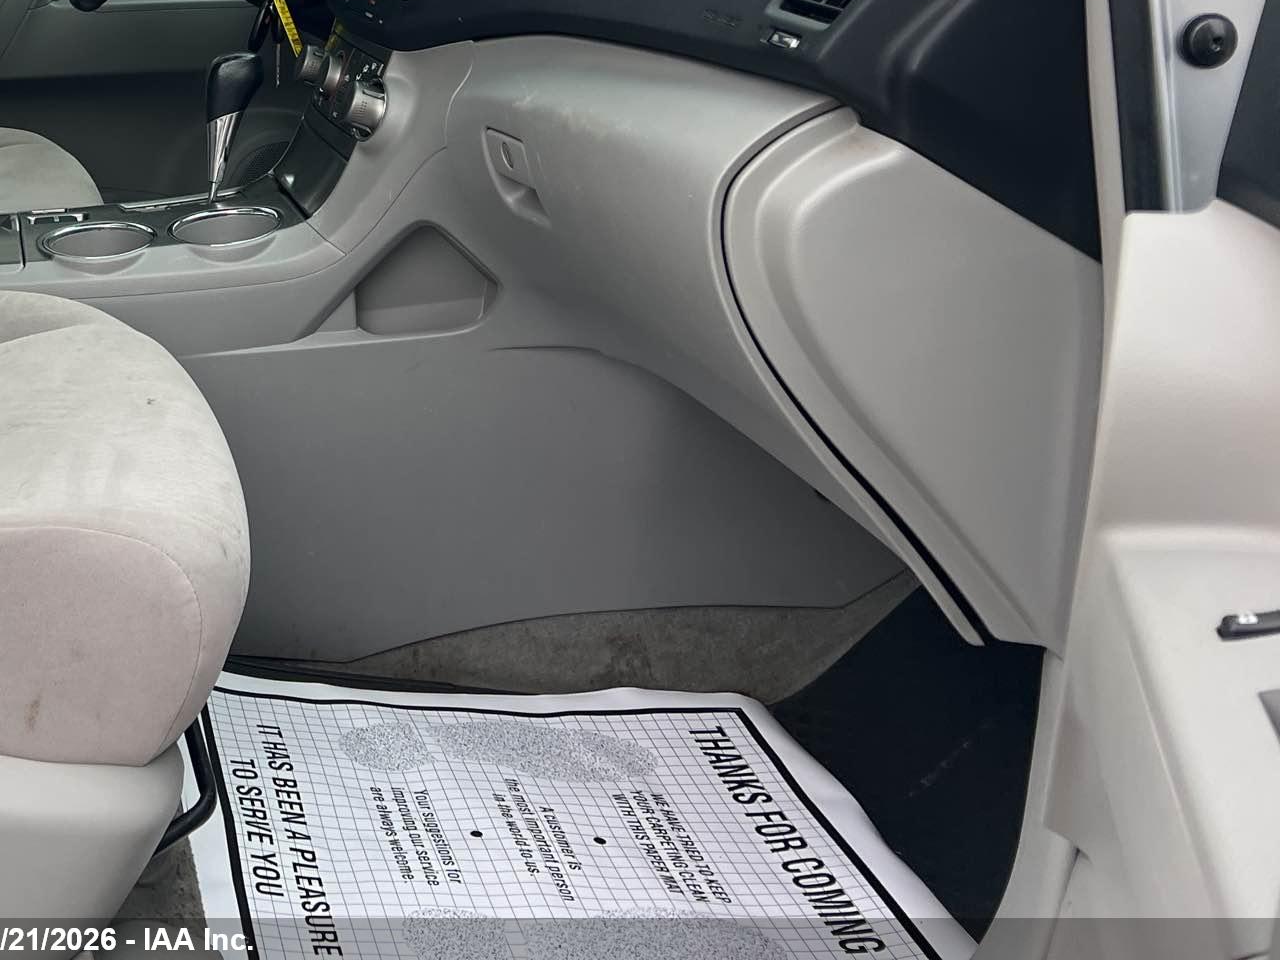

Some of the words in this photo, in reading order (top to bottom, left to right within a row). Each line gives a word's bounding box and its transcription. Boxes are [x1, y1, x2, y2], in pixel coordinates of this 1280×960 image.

[256, 724, 283, 739] IT
[230, 759, 258, 780] TO
[262, 741, 294, 772] HAS
[272, 777, 307, 825] BEEN
[370, 786, 384, 803] are
[391, 786, 417, 831] improving
[414, 789, 431, 815] Your
[493, 792, 506, 803] in
[650, 793, 670, 808] WE
[236, 785, 274, 845] SERVE
[376, 804, 397, 837] always
[497, 804, 514, 820] the
[660, 809, 686, 833] HAVE
[284, 828, 312, 841] A
[409, 833, 425, 848] our
[422, 811, 455, 867] suggestions
[505, 778, 520, 793] the
[513, 794, 534, 816] most
[525, 817, 556, 868] important
[545, 866, 575, 902] person
[506, 821, 530, 849] world
[544, 813, 576, 860] customer
[567, 861, 582, 871] is
[612, 793, 636, 817] WITH
[627, 820, 650, 841] THIS
[640, 842, 670, 873] PAPER
[660, 874, 685, 896] MAT
[630, 790, 655, 815] YOUR
[645, 816, 688, 868] CARPETING
[679, 871, 710, 903] CLEAN
[677, 834, 705, 862] TRIED
[688, 725, 773, 805] THANKS
[744, 810, 808, 853] FOR
[781, 857, 886, 954] COMING
[389, 839, 414, 884] welcome.
[415, 848, 440, 887] service
[519, 848, 533, 861] to
[251, 853, 284, 897] YOU
[447, 869, 462, 884] for
[525, 862, 540, 877] us.
[695, 864, 715, 877] TO
[289, 847, 343, 957] PLEASURE
[704, 879, 732, 904] KEEP
